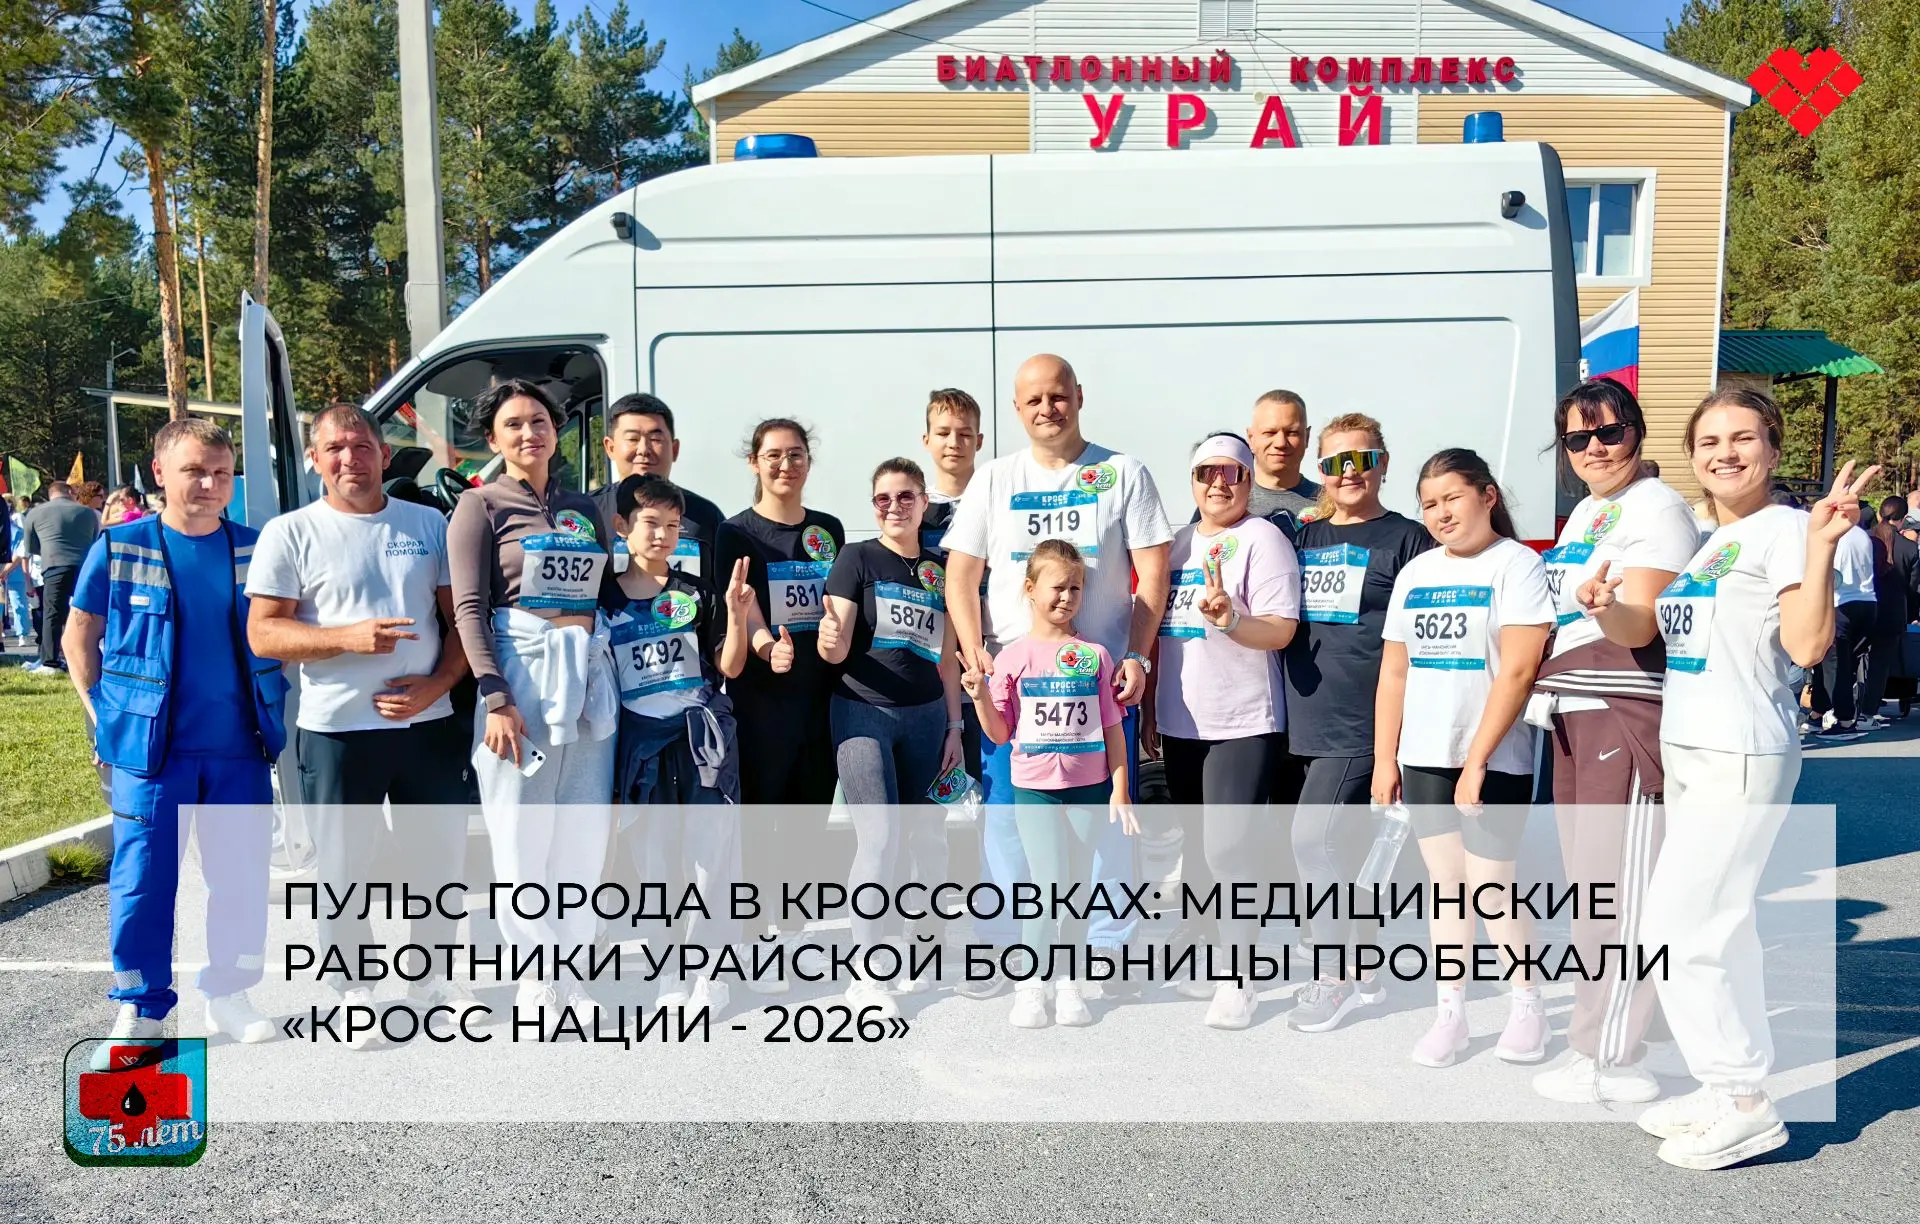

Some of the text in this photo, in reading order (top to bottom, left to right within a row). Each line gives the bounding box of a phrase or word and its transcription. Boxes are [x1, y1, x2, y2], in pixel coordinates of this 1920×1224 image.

[937, 49, 1516, 84] БИАТЛОННЫЙ КОМПЛЕКС
[1082, 85, 1384, 149] УРАЙ
[1091, 472, 1113, 485] 75
[1042, 494, 1068, 503] КРОСС
[1027, 509, 1081, 536] 5119
[385, 548, 429, 558] ПОМОЩЬ
[387, 540, 425, 549] СКОРАЯ
[541, 556, 594, 582] 5352
[1301, 569, 1346, 594] 5988
[671, 603, 690, 618] 75
[1166, 588, 1196, 611] 934
[890, 603, 935, 635] 5874
[1414, 612, 1467, 640] 5623
[631, 638, 685, 671] 5292
[1073, 655, 1094, 669] 75
[1050, 681, 1076, 689] КРОСС
[1034, 701, 1088, 727] 5473
